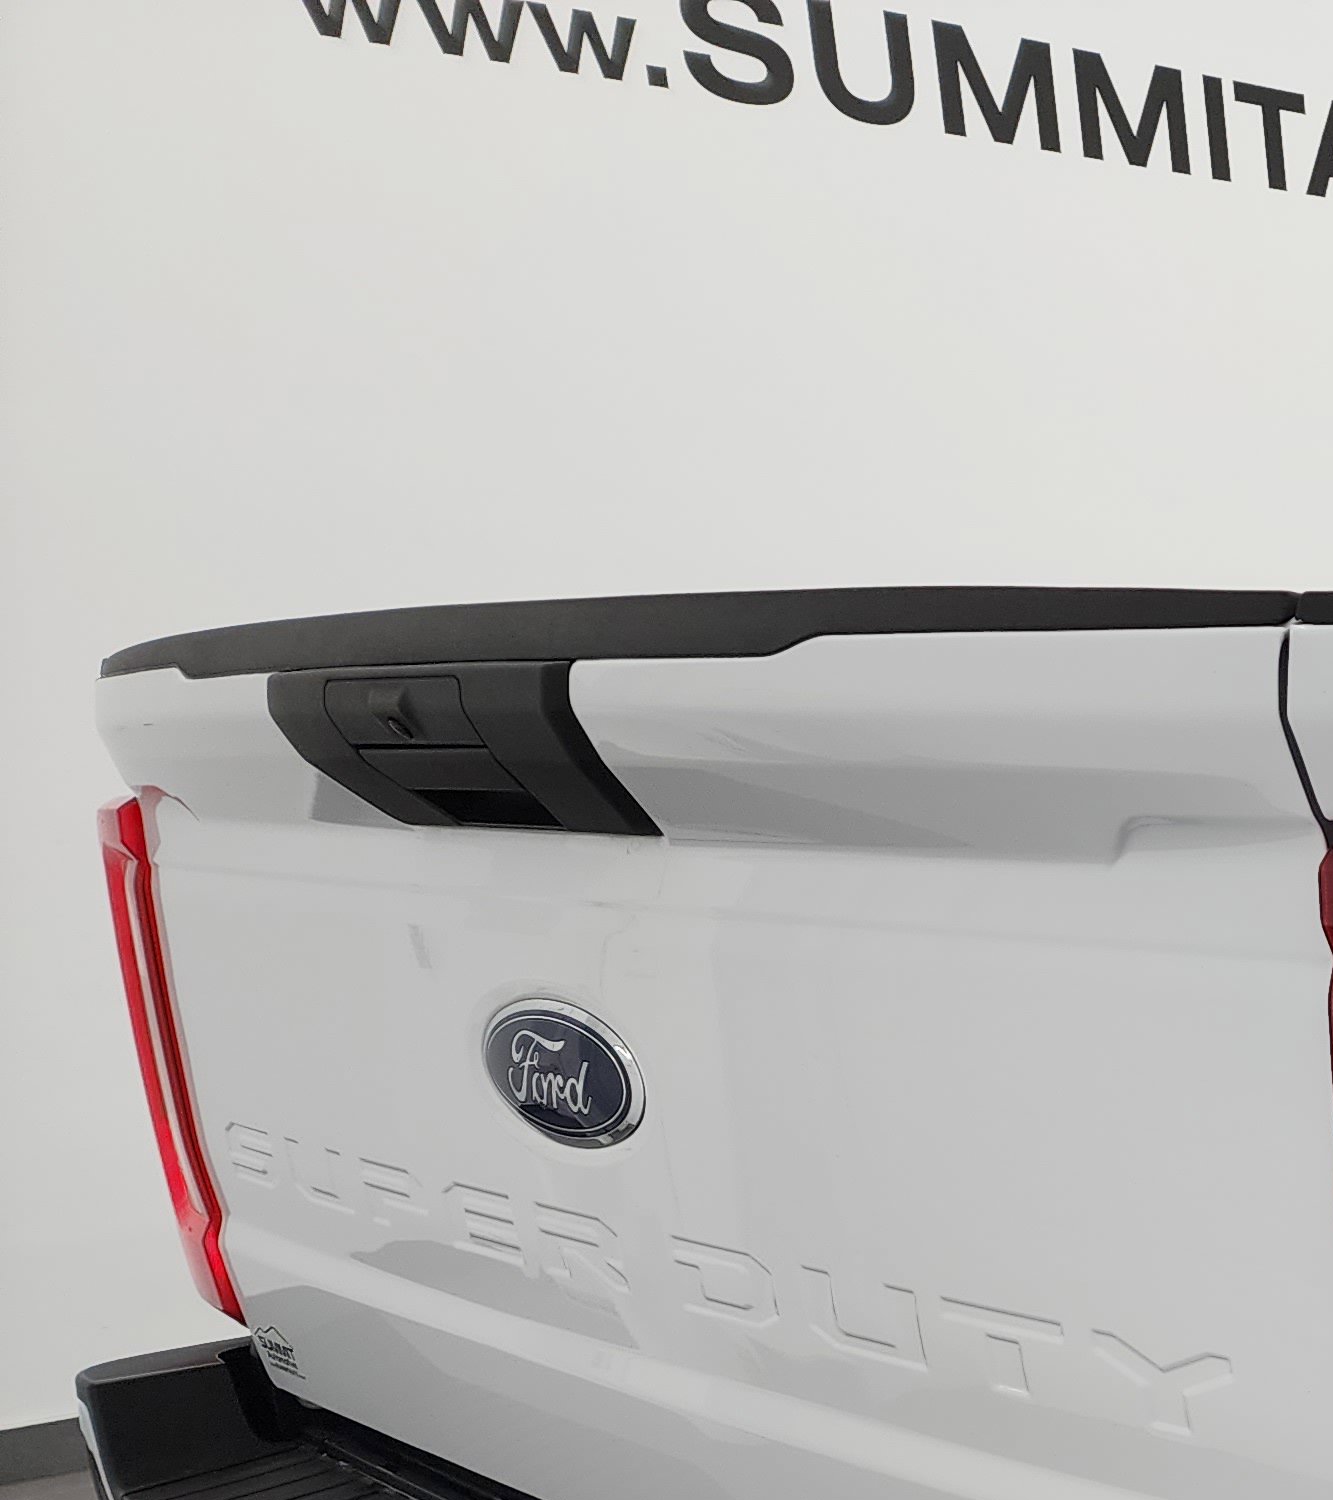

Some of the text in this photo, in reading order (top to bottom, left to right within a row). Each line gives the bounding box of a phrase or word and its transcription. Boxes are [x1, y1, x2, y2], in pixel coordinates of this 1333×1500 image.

[507, 1028, 594, 1116] Ford
[224, 1119, 1234, 1438] SUPER DUTY
